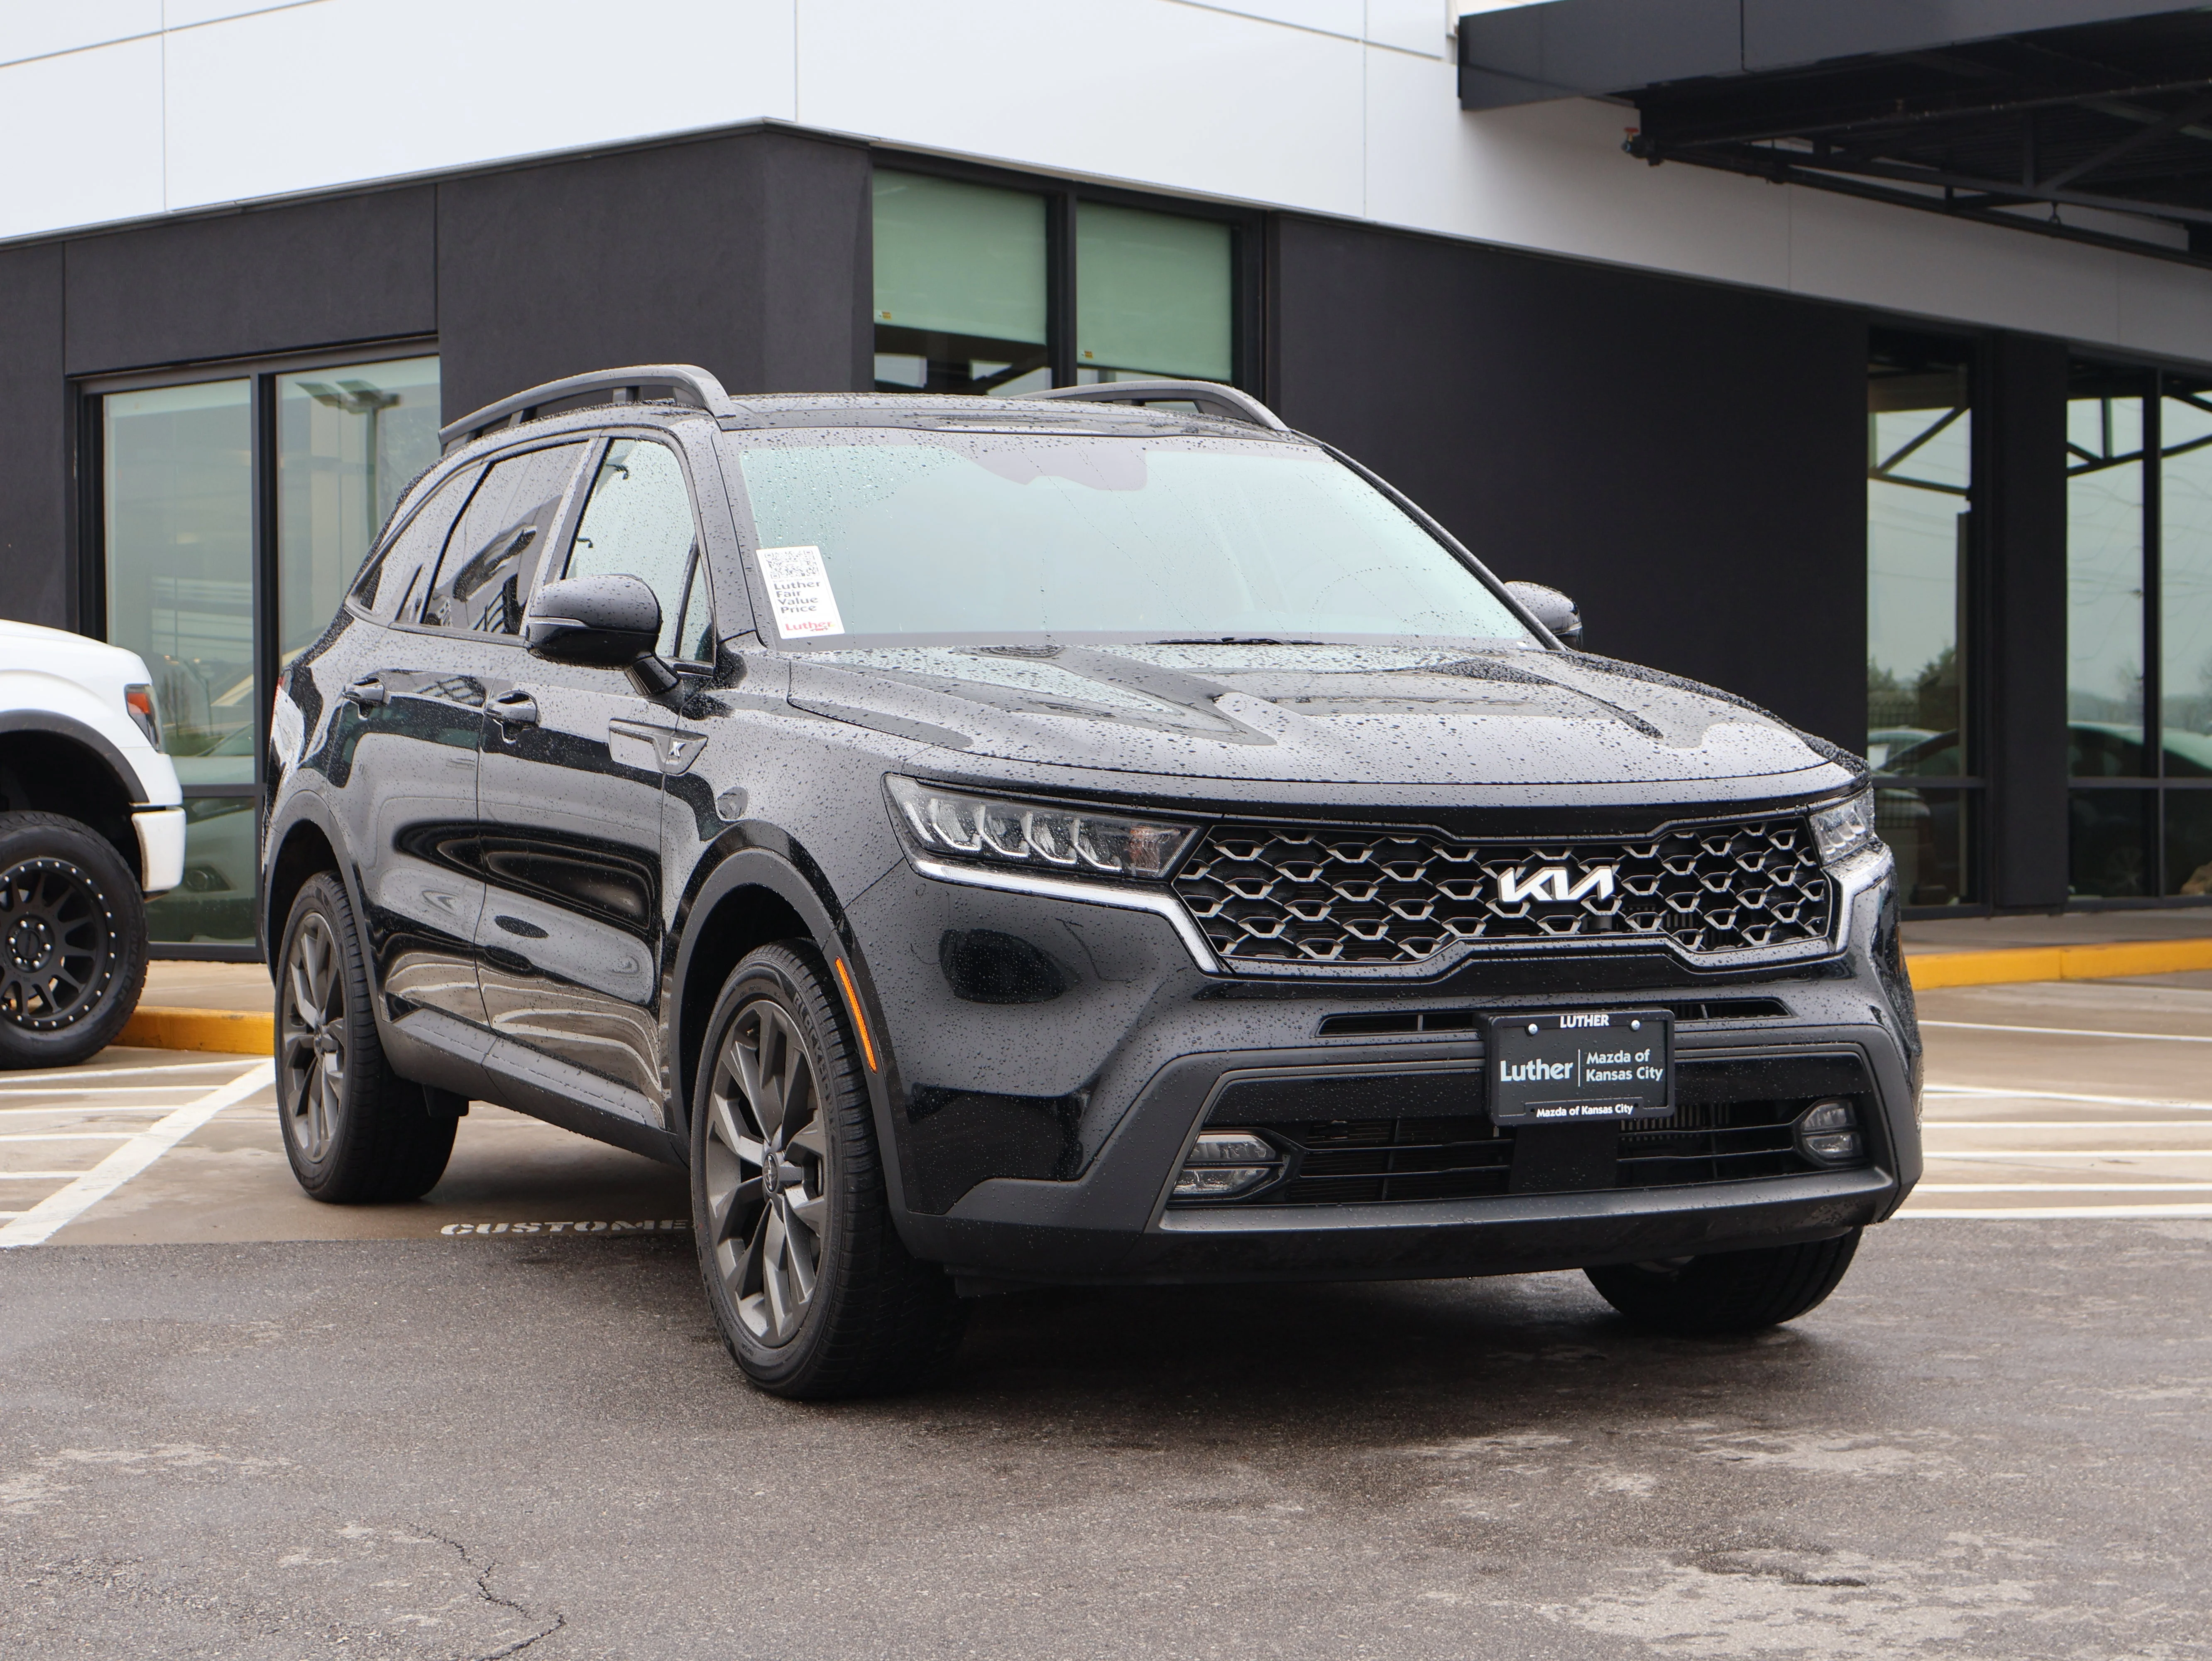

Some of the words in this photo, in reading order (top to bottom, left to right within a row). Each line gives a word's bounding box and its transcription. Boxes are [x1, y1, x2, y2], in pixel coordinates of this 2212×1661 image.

[774, 581, 820, 590] Luther
[781, 605, 817, 614] Price
[785, 621, 832, 631] Luther
[1560, 1014, 1610, 1029] LUTHER
[1586, 1050, 1631, 1065] Mazda
[1635, 1048, 1650, 1062] of
[1500, 1058, 1573, 1082] Luther
[1586, 1068, 1632, 1082] Kansas
[1636, 1066, 1664, 1081] City
[1536, 1107, 1567, 1118] Mazda
[1568, 1105, 1580, 1115] of
[1581, 1105, 1613, 1115] Kansas
[1615, 1103, 1634, 1115] City
[440, 1219, 689, 1235] CUSTOME
